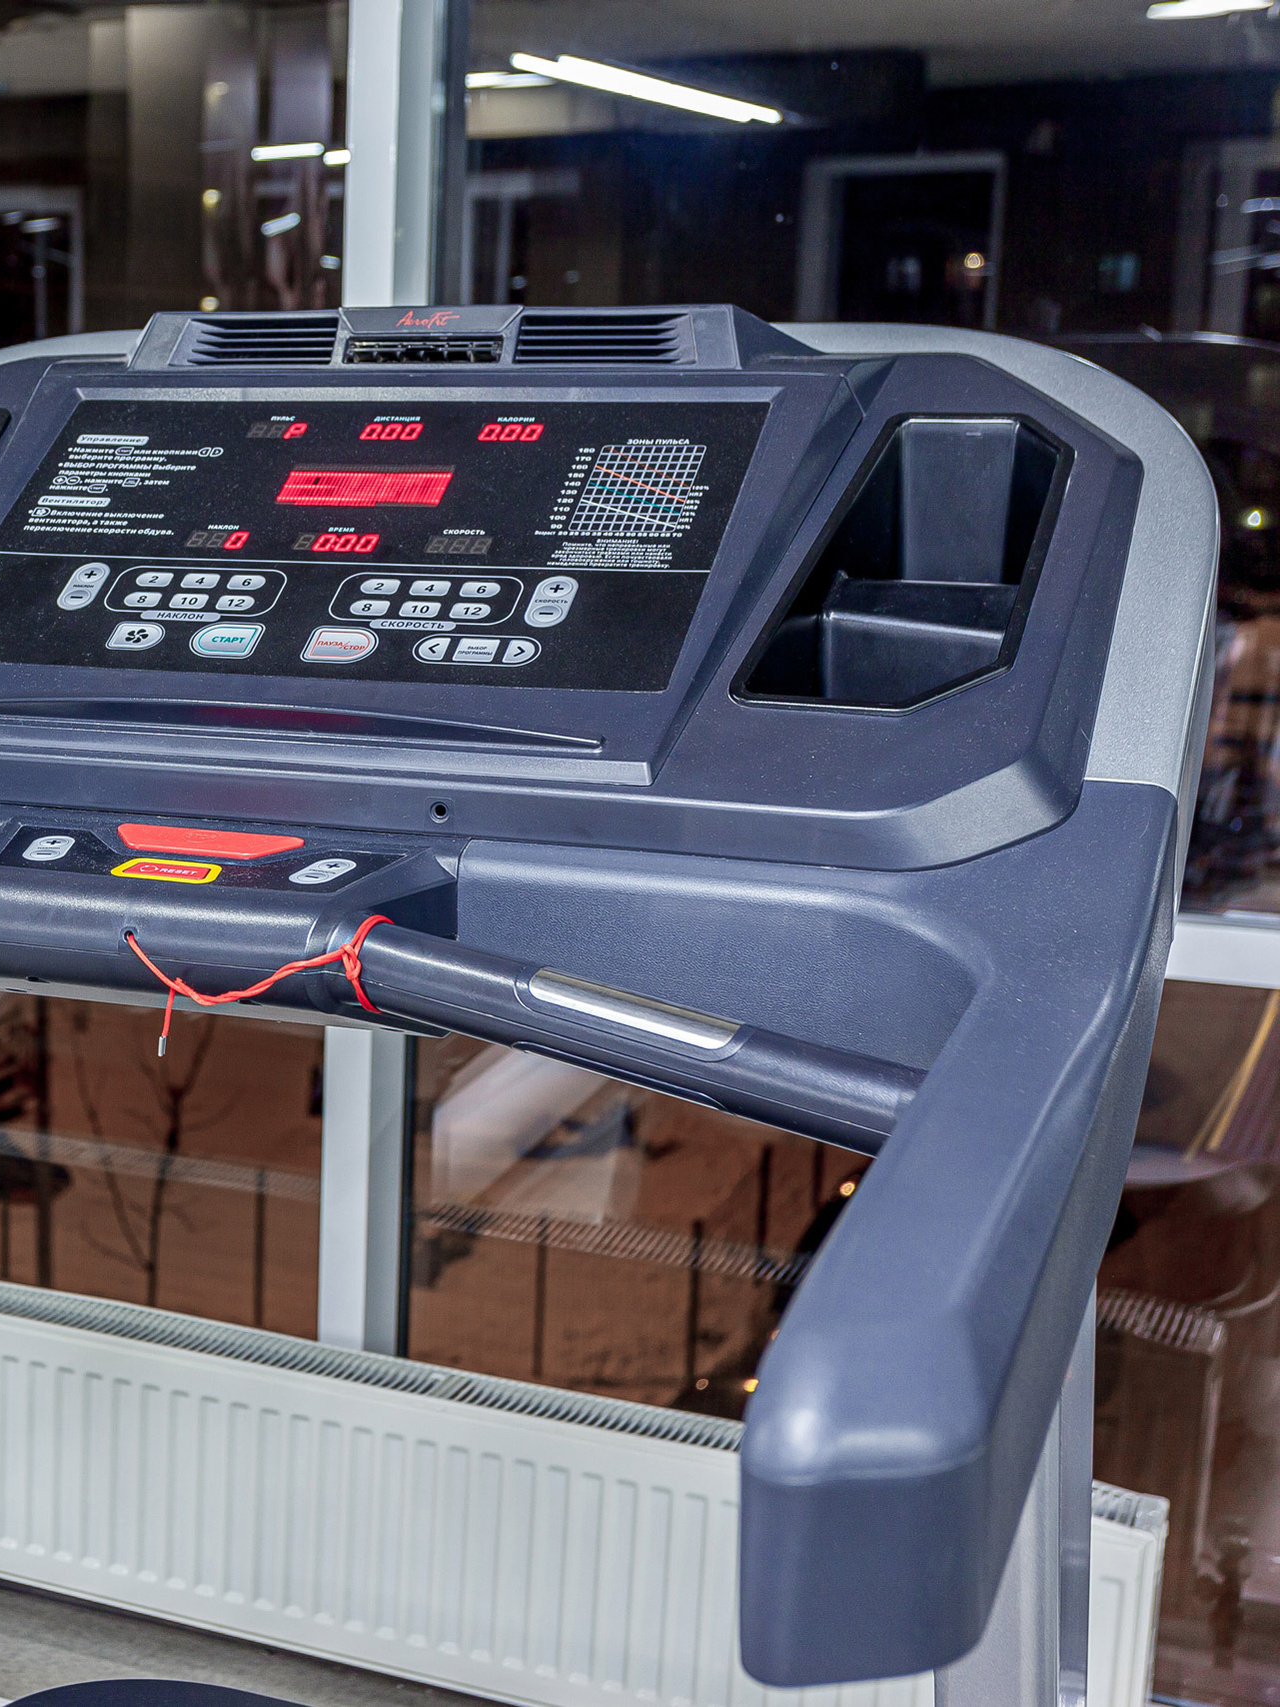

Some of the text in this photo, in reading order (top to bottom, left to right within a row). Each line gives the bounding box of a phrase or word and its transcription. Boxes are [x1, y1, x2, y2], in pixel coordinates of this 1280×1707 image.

[80, 436, 145, 444] Управление:
[114, 455, 167, 463] программу.
[49, 484, 88, 492] нажмите
[41, 497, 108, 506] Вентилятор:
[50, 510, 103, 518] Включение
[28, 518, 90, 526] вентилятора,
[24, 525, 92, 533] переключение
[93, 527, 137, 535] скорости
[312, 534, 380, 552] 0:00
[149, 576, 159, 584] 2
[195, 577, 206, 585] 4
[242, 578, 252, 586] 6
[374, 582, 384, 591] 2
[424, 584, 435, 592] 4
[476, 585, 487, 594] 6
[180, 597, 198, 605] 10
[227, 598, 246, 607] 12
[361, 603, 372, 612] 8
[411, 605, 430, 614] 10
[462, 606, 481, 615] 12
[157, 612, 205, 620] НАКЛОН
[380, 620, 444, 629] СКОРОСТЬ
[212, 635, 245, 644] СТАРТ
